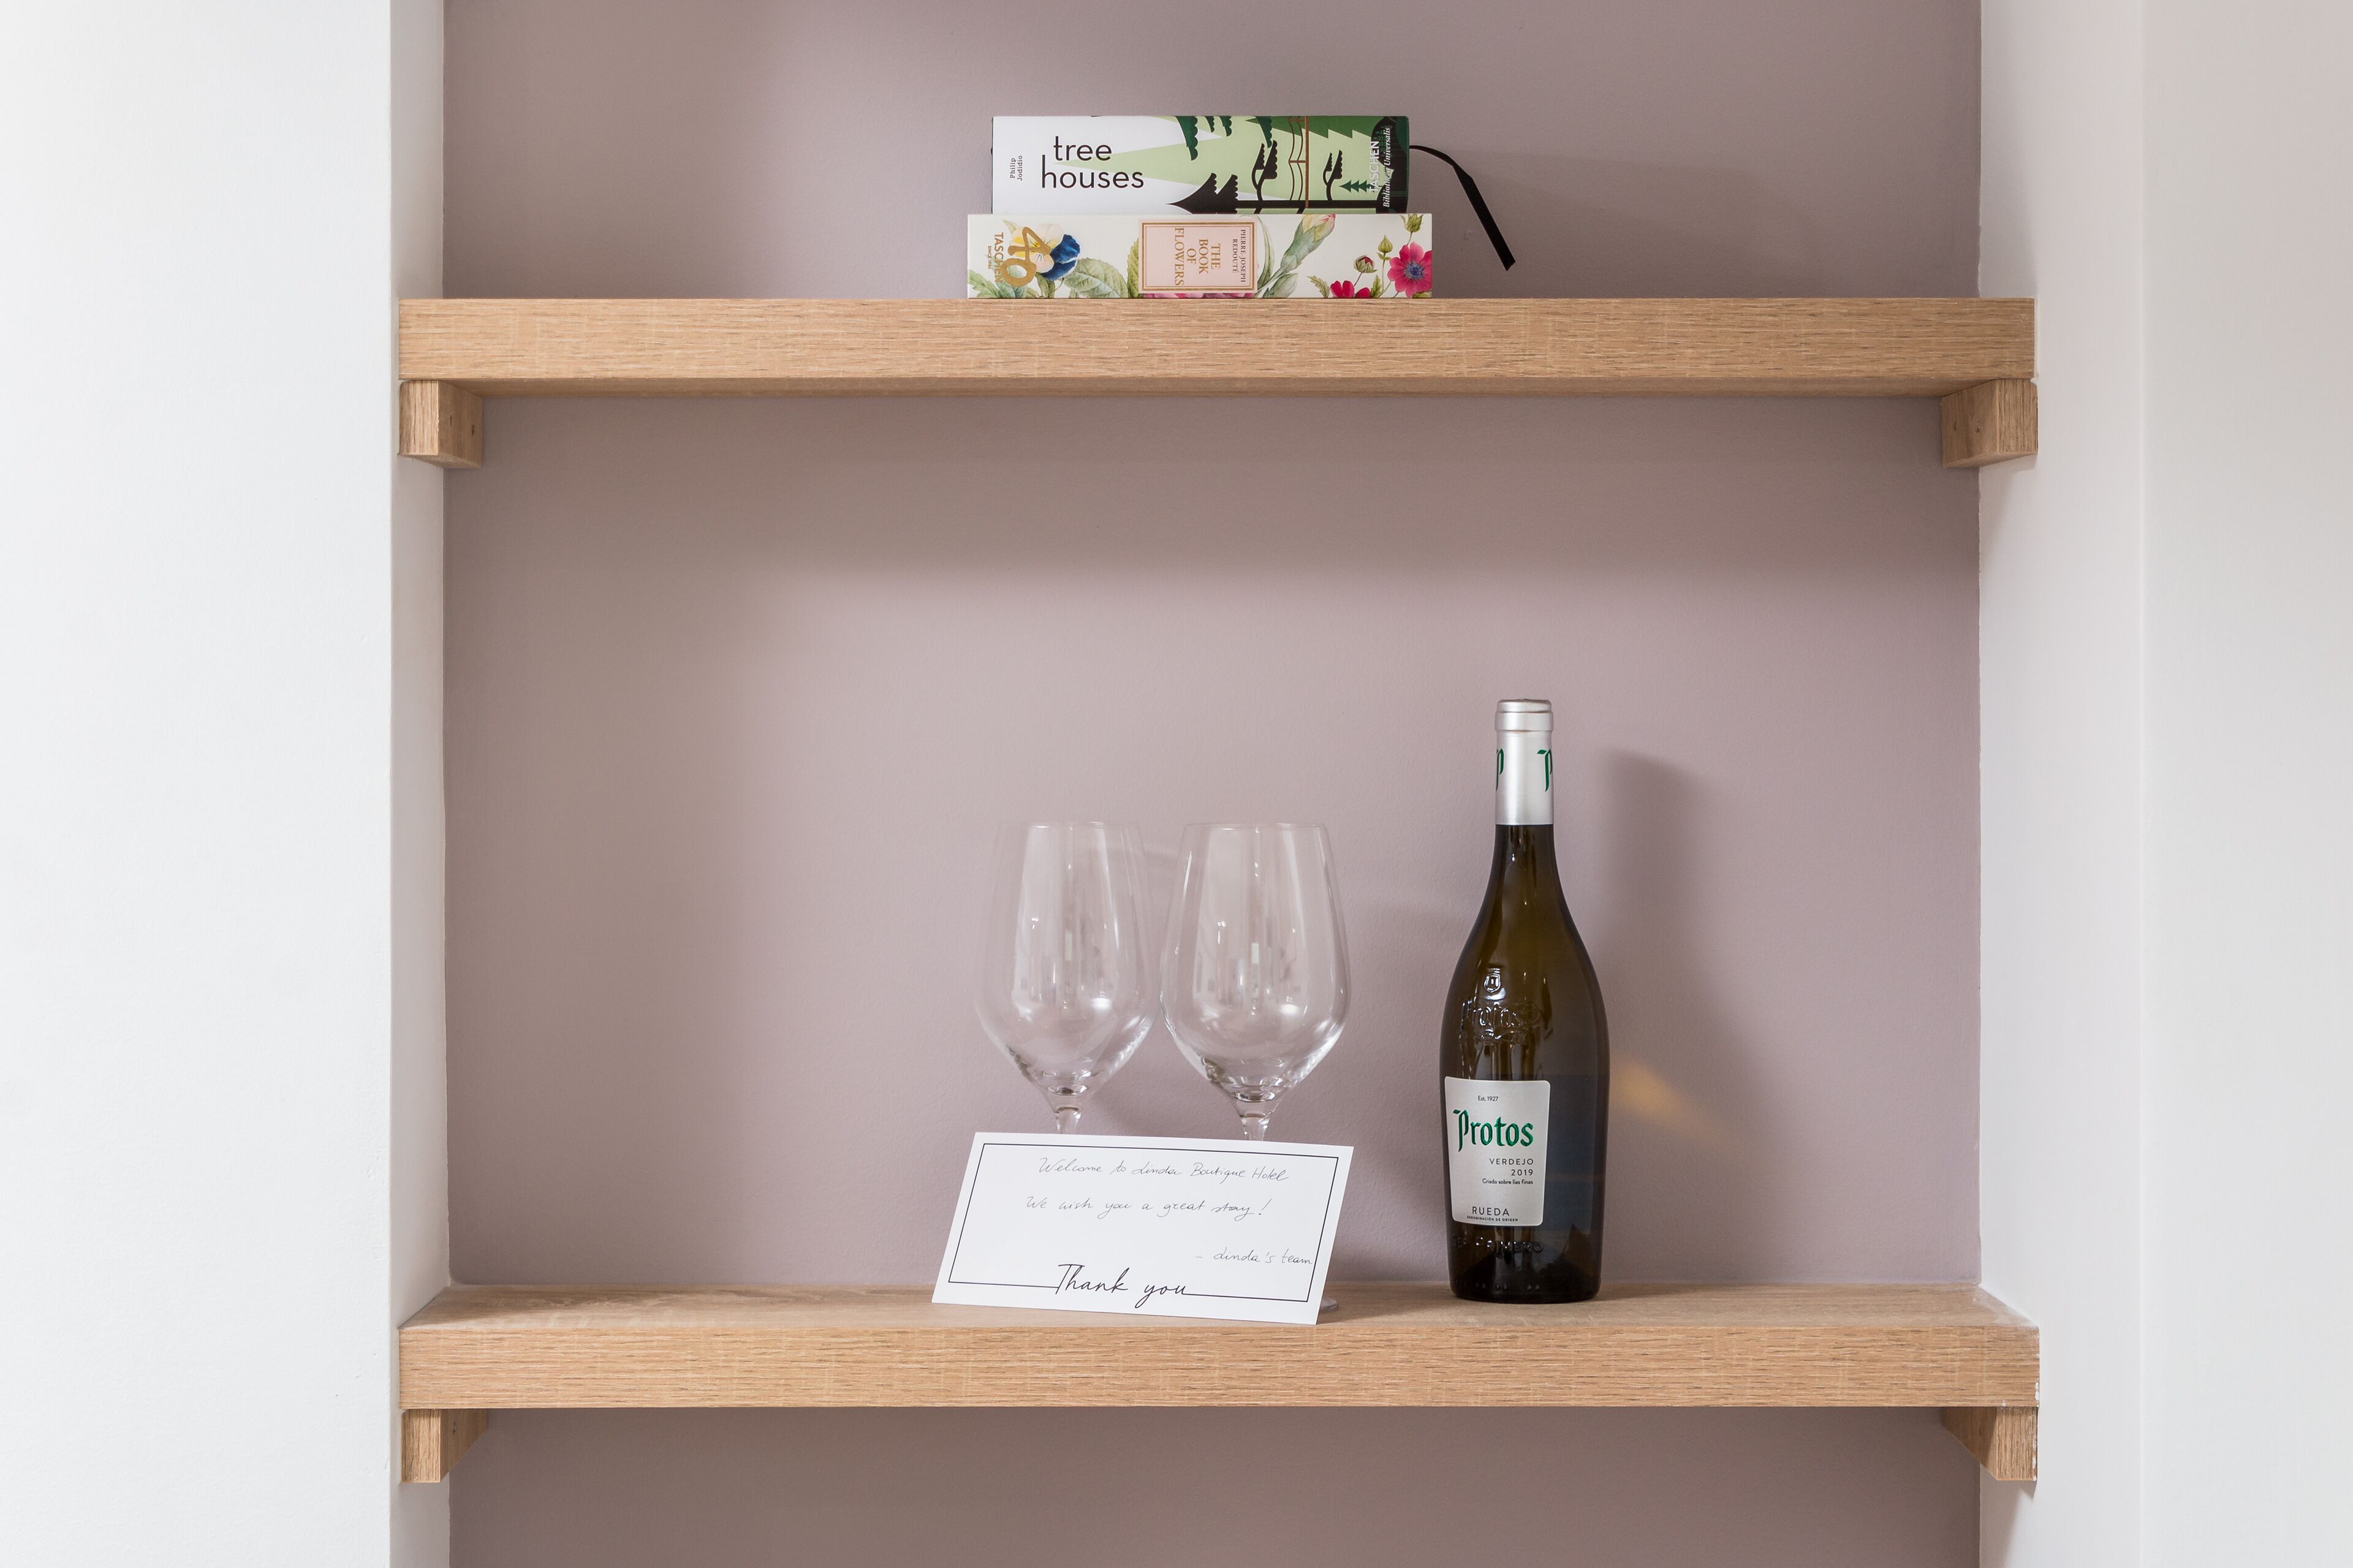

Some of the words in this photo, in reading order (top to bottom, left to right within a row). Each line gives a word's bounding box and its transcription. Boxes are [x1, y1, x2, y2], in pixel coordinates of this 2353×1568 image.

[1053, 136, 1112, 161] tree
[1042, 154, 1144, 189] houses
[1369, 141, 1379, 193] TASCHEN
[994, 232, 1004, 282] TASCHEN
[1175, 228, 1184, 286] FLOWERS
[1187, 248, 1196, 265] OF
[1199, 239, 1208, 275] BOOK
[1211, 243, 1221, 269] THE
[1453, 1109, 1534, 1152] Protos
[1039, 1157, 1103, 1173] Welcome
[1110, 1160, 1126, 1175] to
[1190, 1162, 1246, 1184] Boutique
[1252, 1165, 1289, 1181] Hotel
[1026, 1196, 1048, 1209] We
[1059, 1197, 1093, 1210] wish
[1097, 1202, 1132, 1219] you
[1156, 1200, 1205, 1218] great
[1472, 1206, 1509, 1216] RUEDA
[1281, 1249, 1312, 1265] team
[1055, 1263, 1130, 1294] Thank
[1134, 1285, 1186, 1308] you
